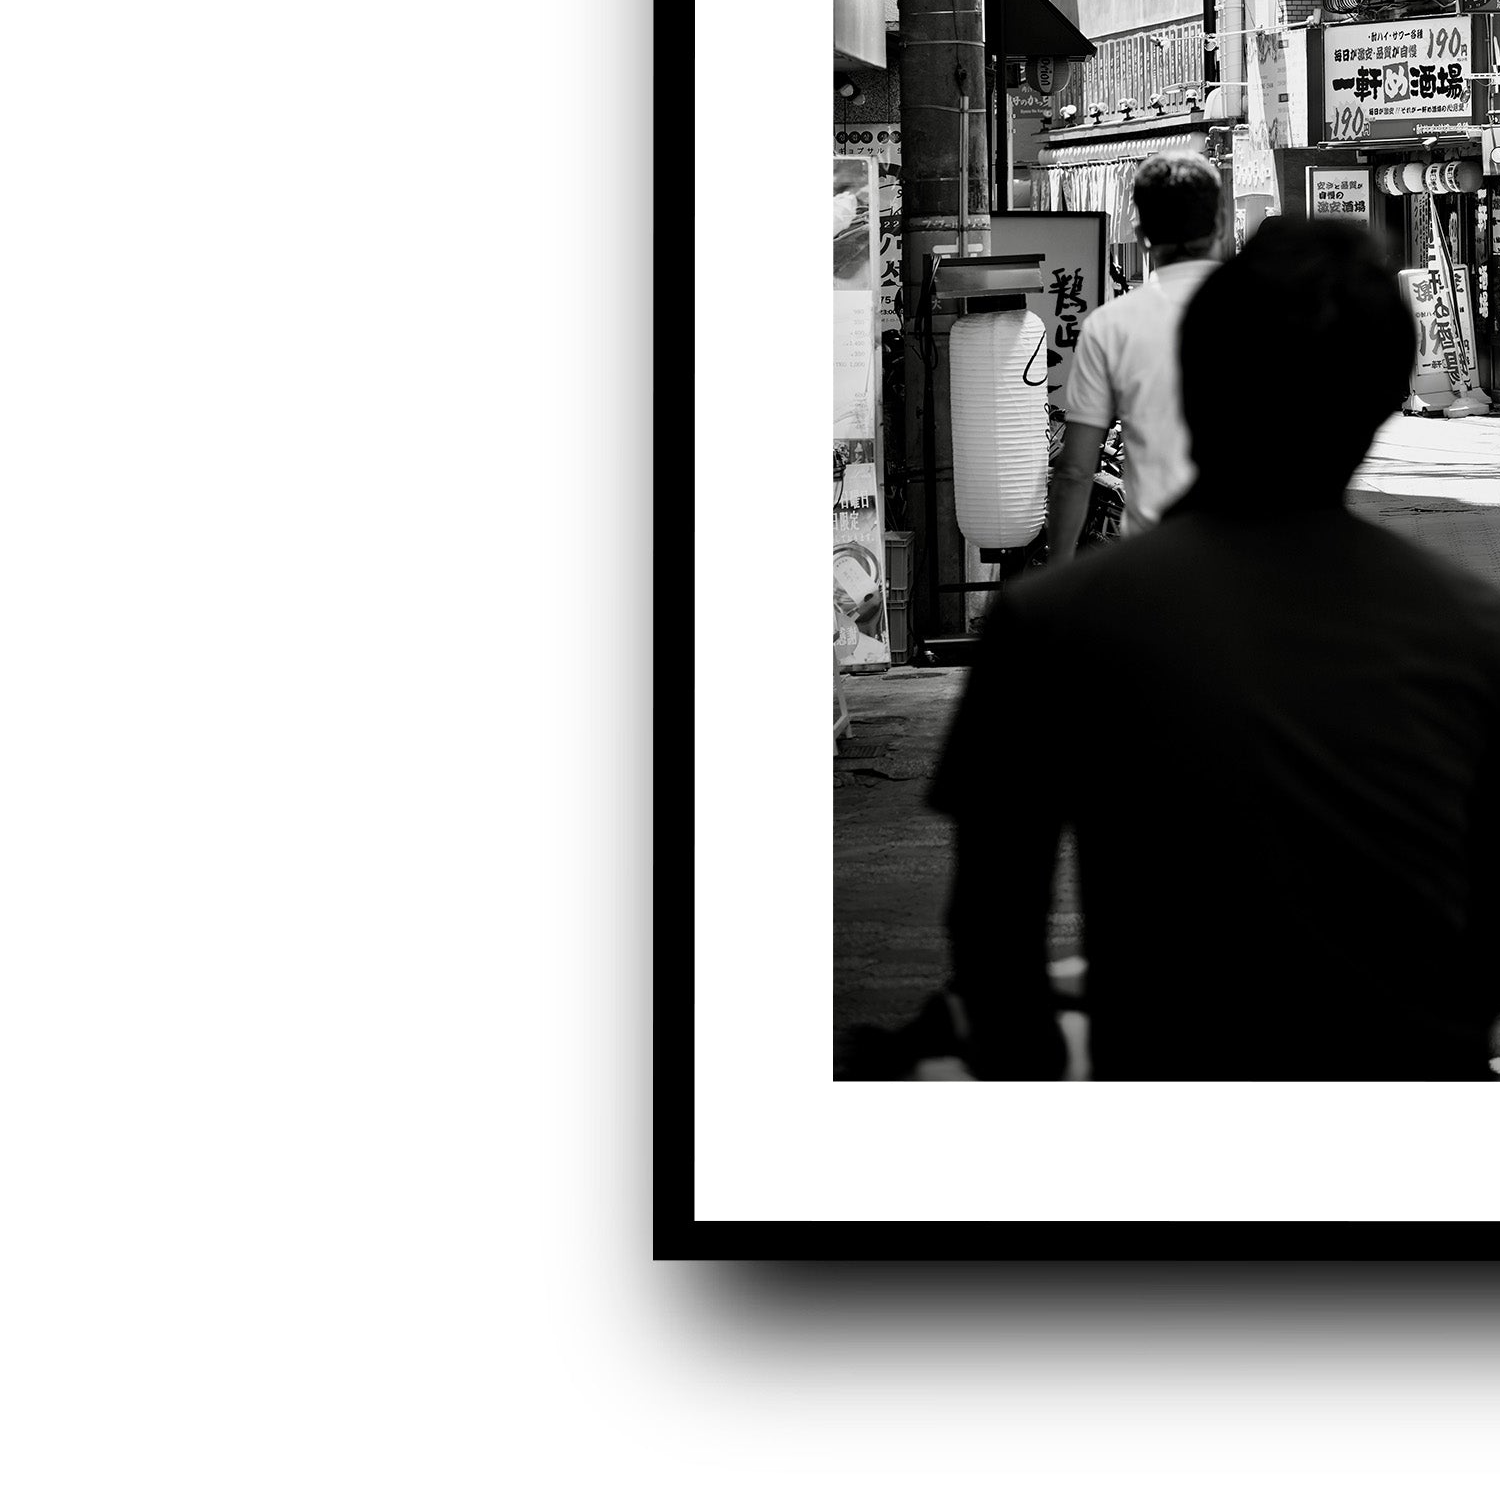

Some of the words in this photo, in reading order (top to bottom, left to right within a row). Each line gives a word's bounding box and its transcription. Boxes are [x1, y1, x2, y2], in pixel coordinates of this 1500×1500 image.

[1332, 61, 1464, 104] 一軒め酒場
